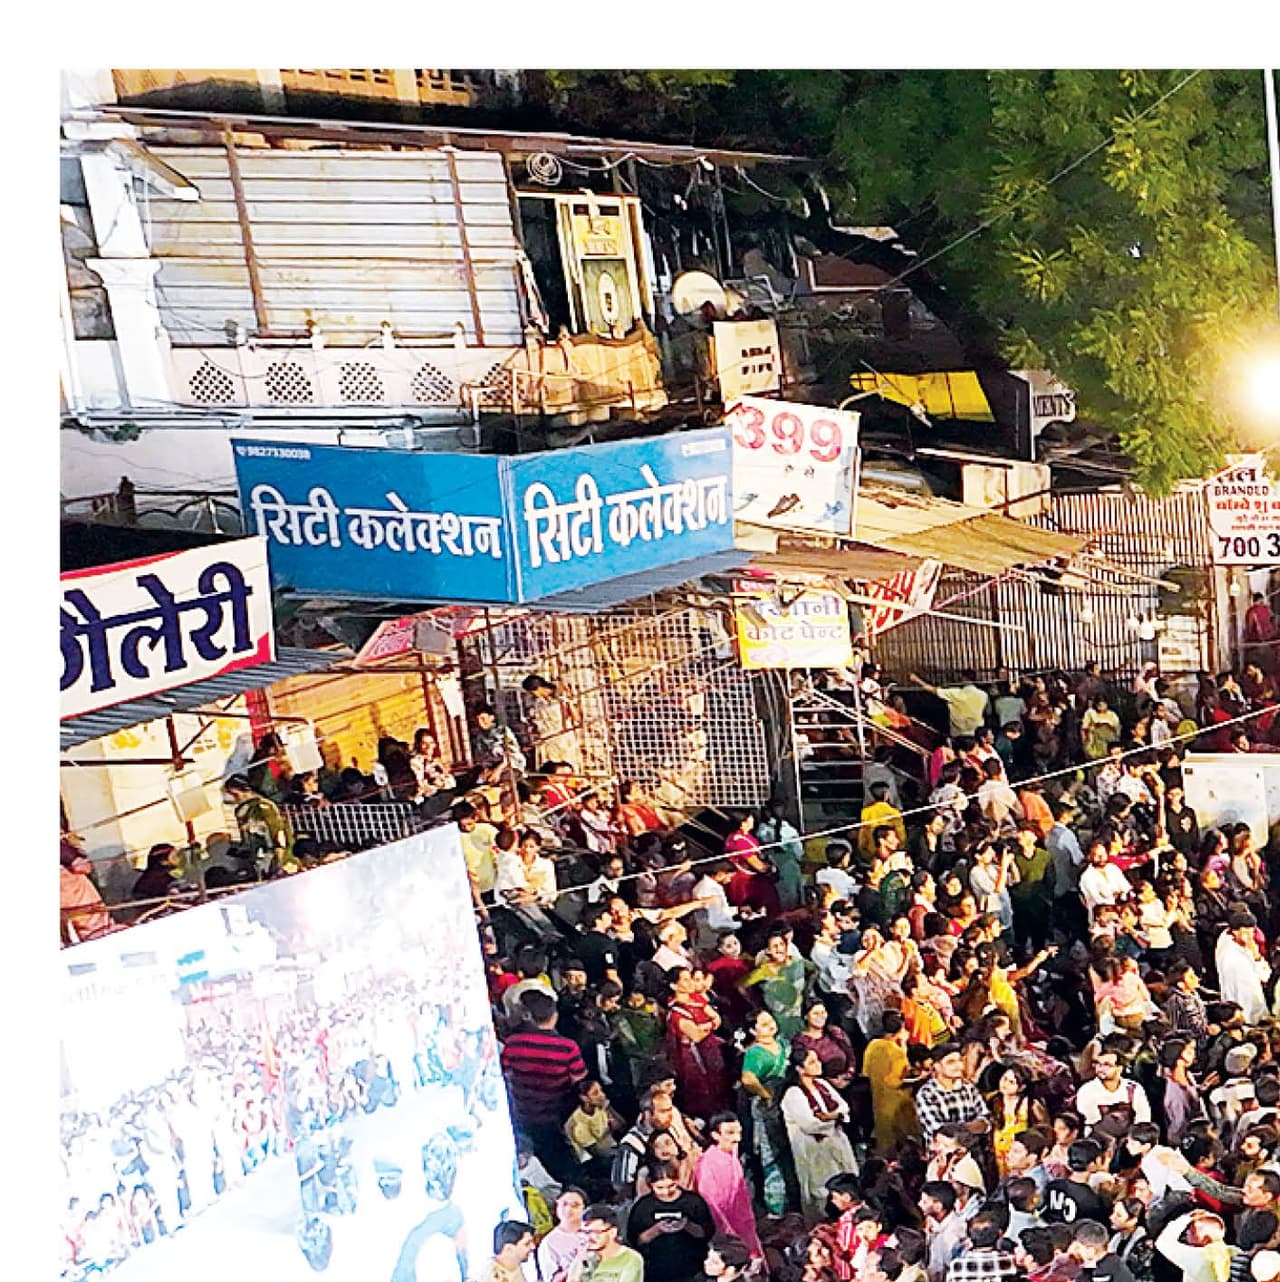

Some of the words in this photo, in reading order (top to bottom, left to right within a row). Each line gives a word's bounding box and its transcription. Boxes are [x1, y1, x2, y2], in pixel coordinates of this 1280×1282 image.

[734, 406, 842, 462] 399
[524, 473, 604, 569] सिटी
[606, 464, 728, 546] कलेक्शन
[1214, 485, 1270, 497] BRANDED
[251, 484, 341, 548] सिटी
[344, 491, 501, 558] कलेक्शन
[1218, 536, 1260, 558] 700
